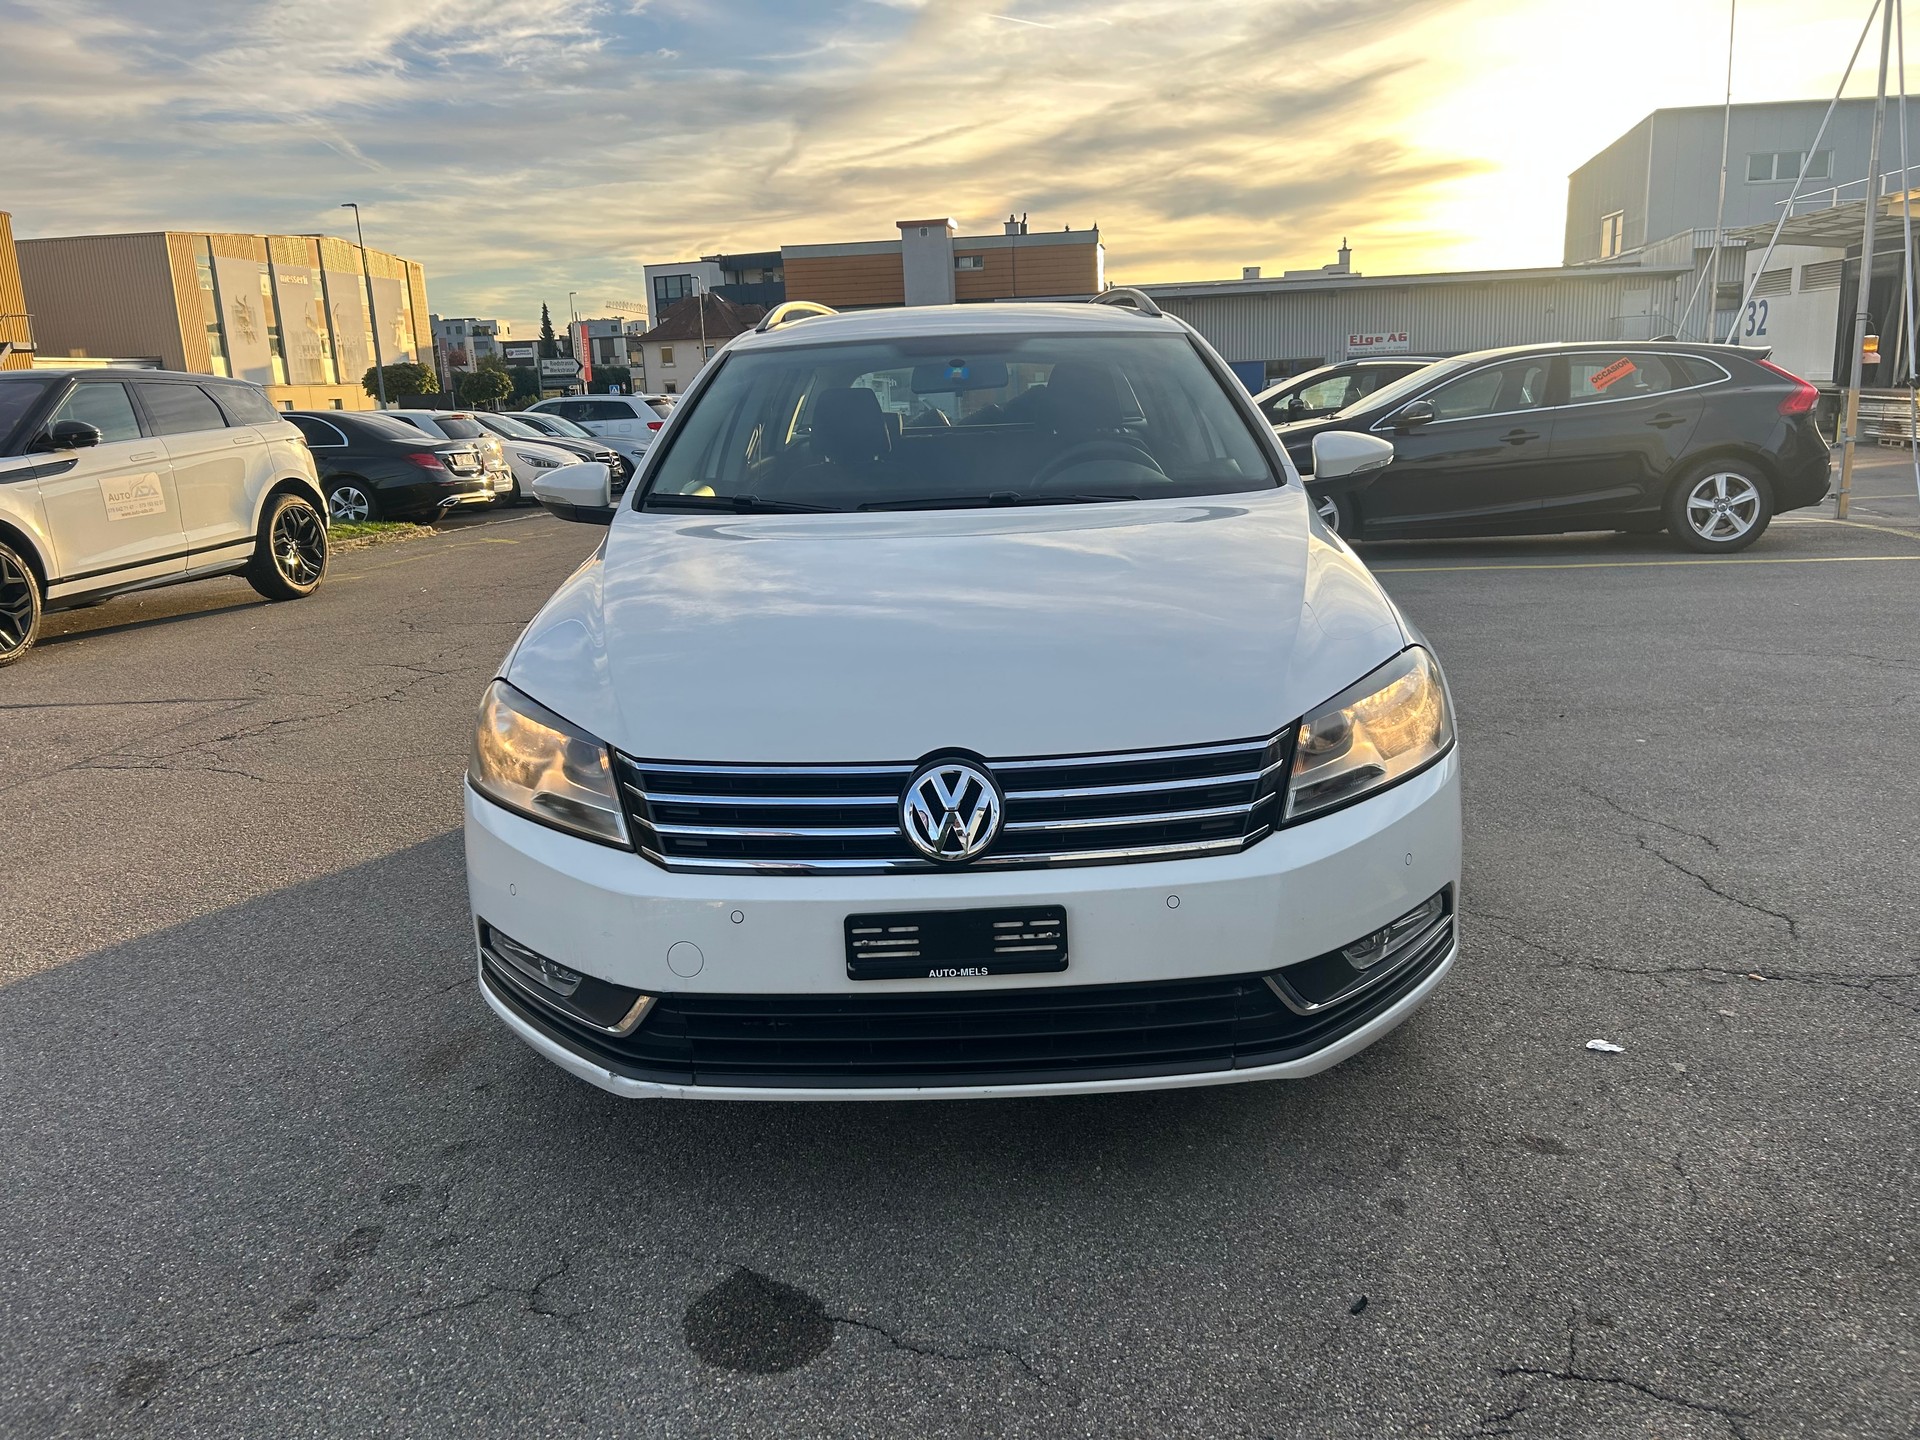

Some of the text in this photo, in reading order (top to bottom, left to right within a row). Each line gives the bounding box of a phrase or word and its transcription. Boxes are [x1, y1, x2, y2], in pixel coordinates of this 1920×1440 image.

[279, 274, 308, 285] messerli
[1745, 299, 1768, 337] 32
[1349, 335, 1384, 347] Elge
[1591, 358, 1630, 384] OCCASION
[928, 966, 989, 978] AUTO-MELS
